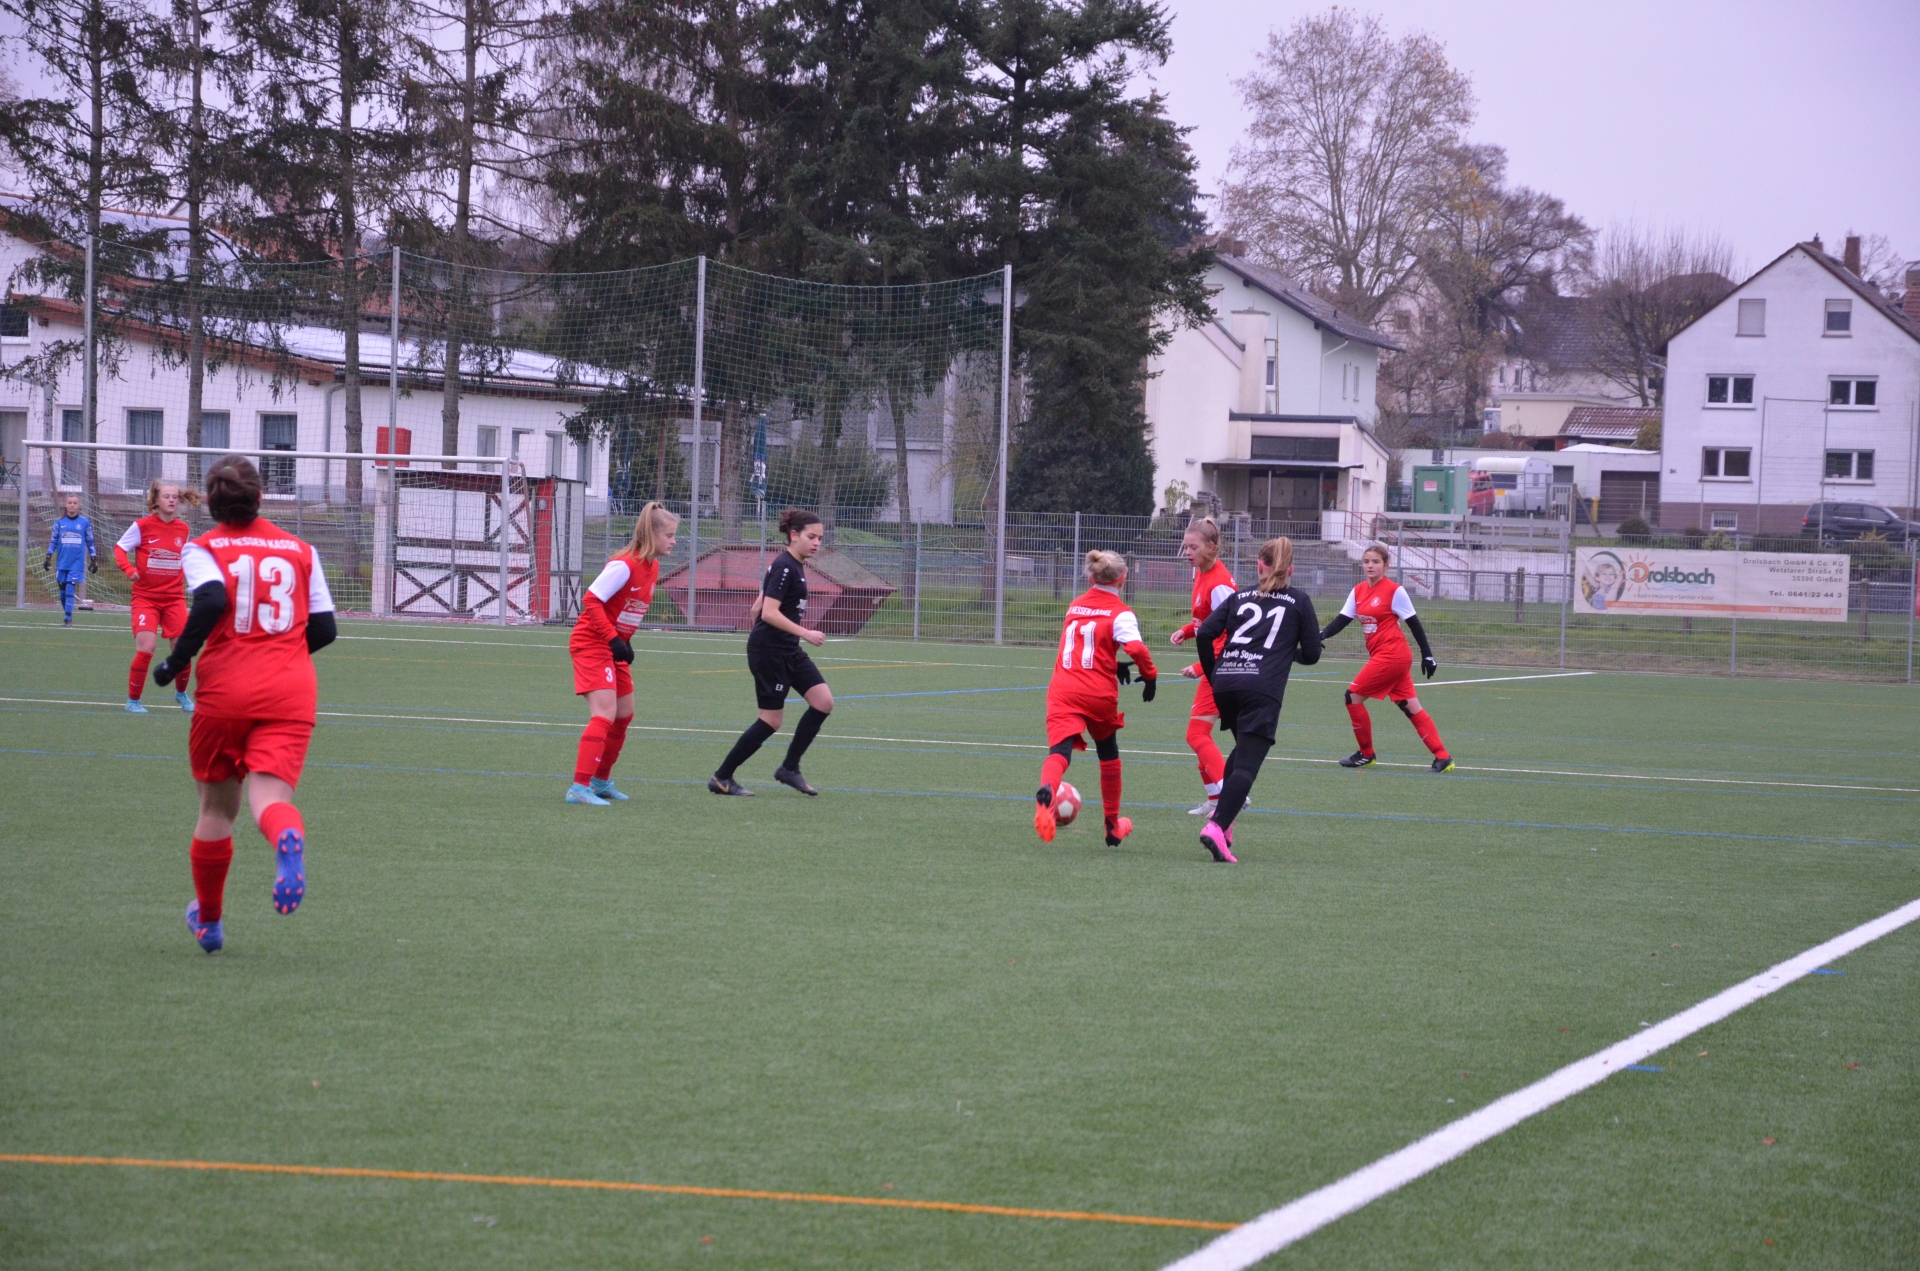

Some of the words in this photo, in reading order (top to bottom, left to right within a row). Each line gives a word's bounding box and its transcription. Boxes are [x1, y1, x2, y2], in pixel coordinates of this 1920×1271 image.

[209, 537, 230, 548] KSV
[268, 539, 303, 553] KASSEL
[1628, 562, 1715, 585] Drolsbach
[228, 554, 296, 635] 13
[1237, 591, 1252, 600] TSV
[1651, 593, 1673, 601] Heizung
[138, 614, 146, 626] 2
[1230, 602, 1286, 649] 21
[1062, 620, 1097, 669] 11
[604, 666, 614, 683] 3
